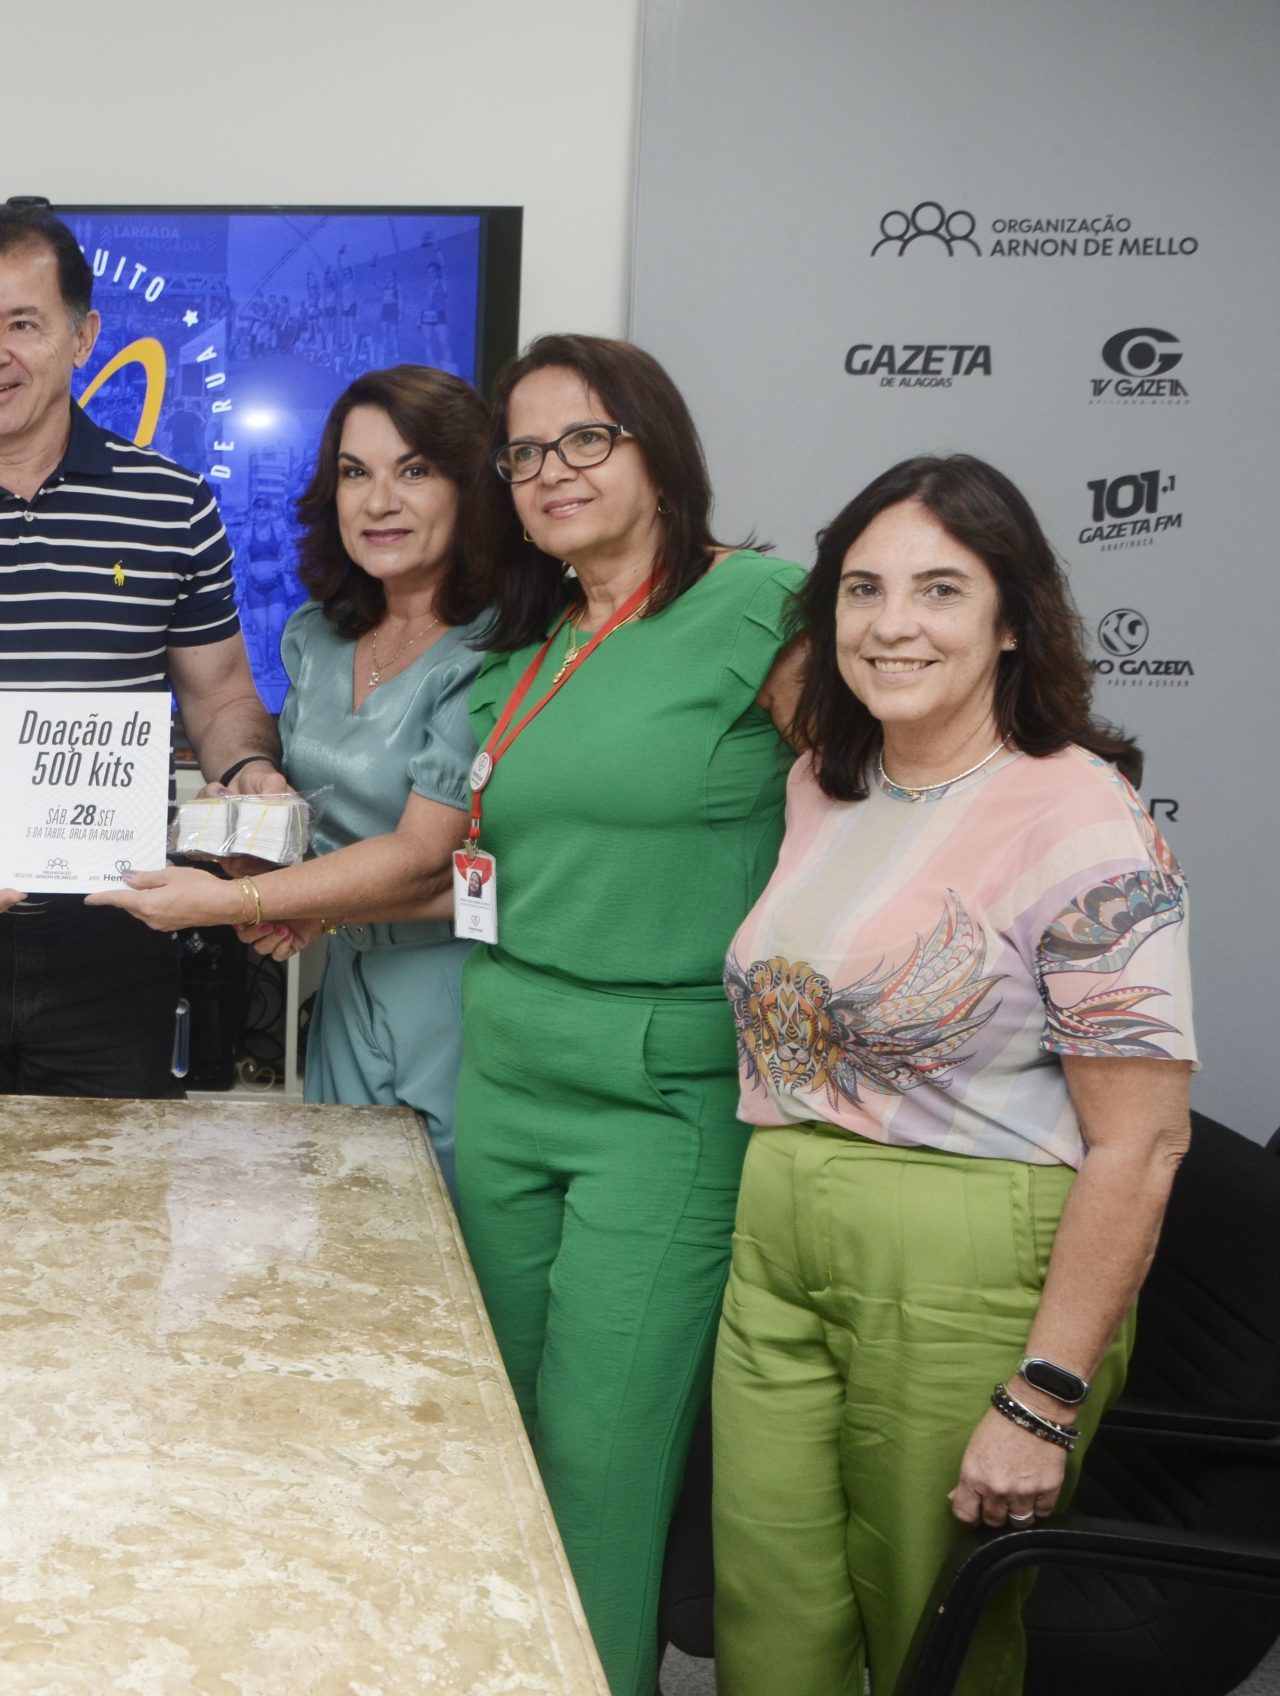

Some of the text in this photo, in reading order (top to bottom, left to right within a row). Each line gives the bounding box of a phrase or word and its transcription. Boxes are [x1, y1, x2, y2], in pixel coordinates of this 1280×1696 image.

[113, 225, 180, 239] LARGADA
[991, 214, 1132, 236] ORGANIZAÇÃO
[989, 236, 1199, 257] ARNON DE MELLO
[79, 245, 166, 303] UITO
[844, 343, 992, 376] GAZETA
[195, 344, 234, 414] RUA
[880, 377, 953, 388] DE ALAGOAS
[1090, 379, 1189, 397] TV GAZETA
[1078, 513, 1183, 545] GAZETA FM
[1119, 659, 1195, 676] GAZETA
[18, 710, 152, 753] Doação de
[32, 751, 135, 788] 500 kits
[26, 827, 31, 838] 5
[33, 827, 42, 838] DA
[68, 828, 87, 840] ORLA
[88, 829, 98, 840] DA
[100, 829, 135, 843] PAJUÇARA
